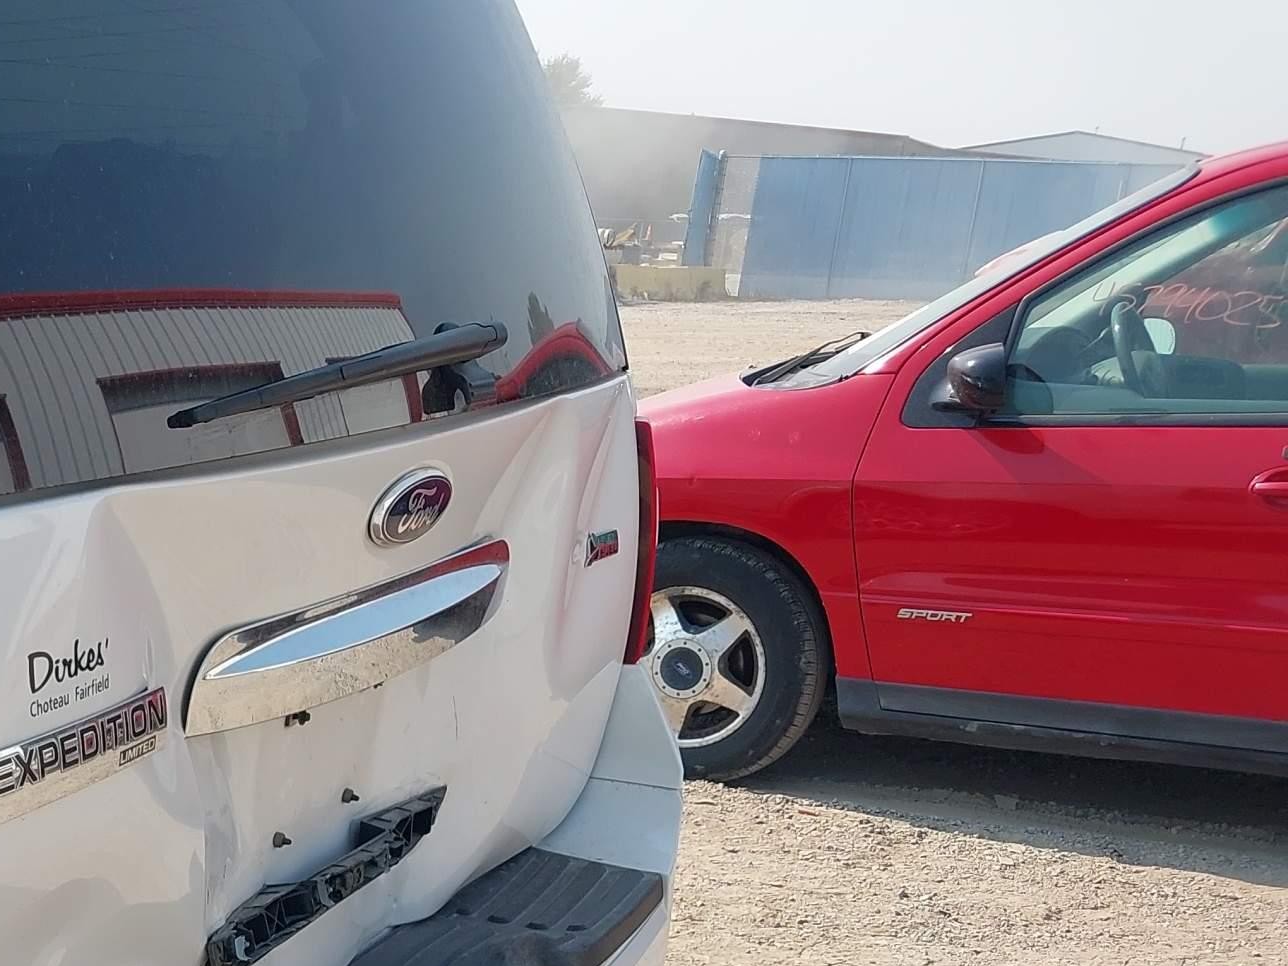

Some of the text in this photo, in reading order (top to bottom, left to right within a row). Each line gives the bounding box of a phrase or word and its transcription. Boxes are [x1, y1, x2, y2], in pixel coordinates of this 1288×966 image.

[397, 485, 445, 535] Ford
[896, 607, 973, 623] SPORT
[27, 637, 110, 694] Dirkes'
[29, 673, 110, 718] Choteau Fairfield
[119, 736, 157, 766] LIMITED
